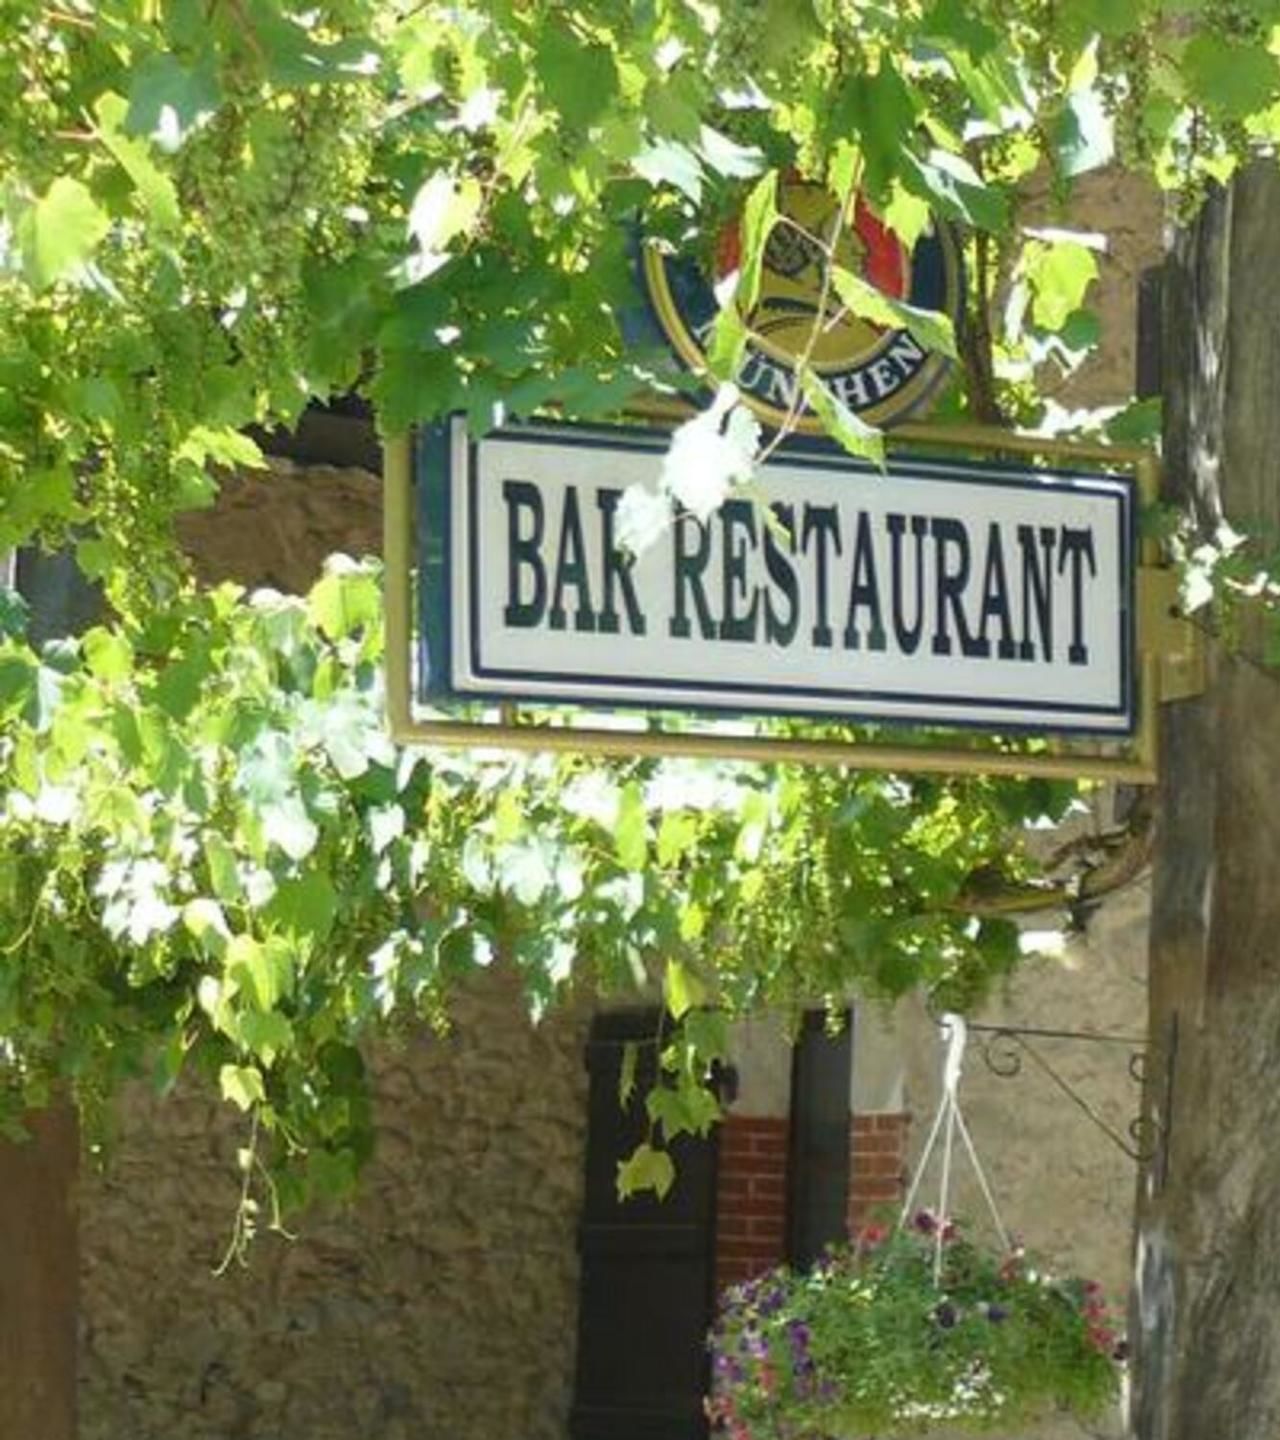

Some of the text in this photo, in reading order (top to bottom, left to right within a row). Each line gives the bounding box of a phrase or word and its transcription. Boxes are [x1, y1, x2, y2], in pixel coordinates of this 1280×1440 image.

[694, 320, 924, 408] ÜNHEN
[502, 480, 1096, 667] BAR RESTAURANT
